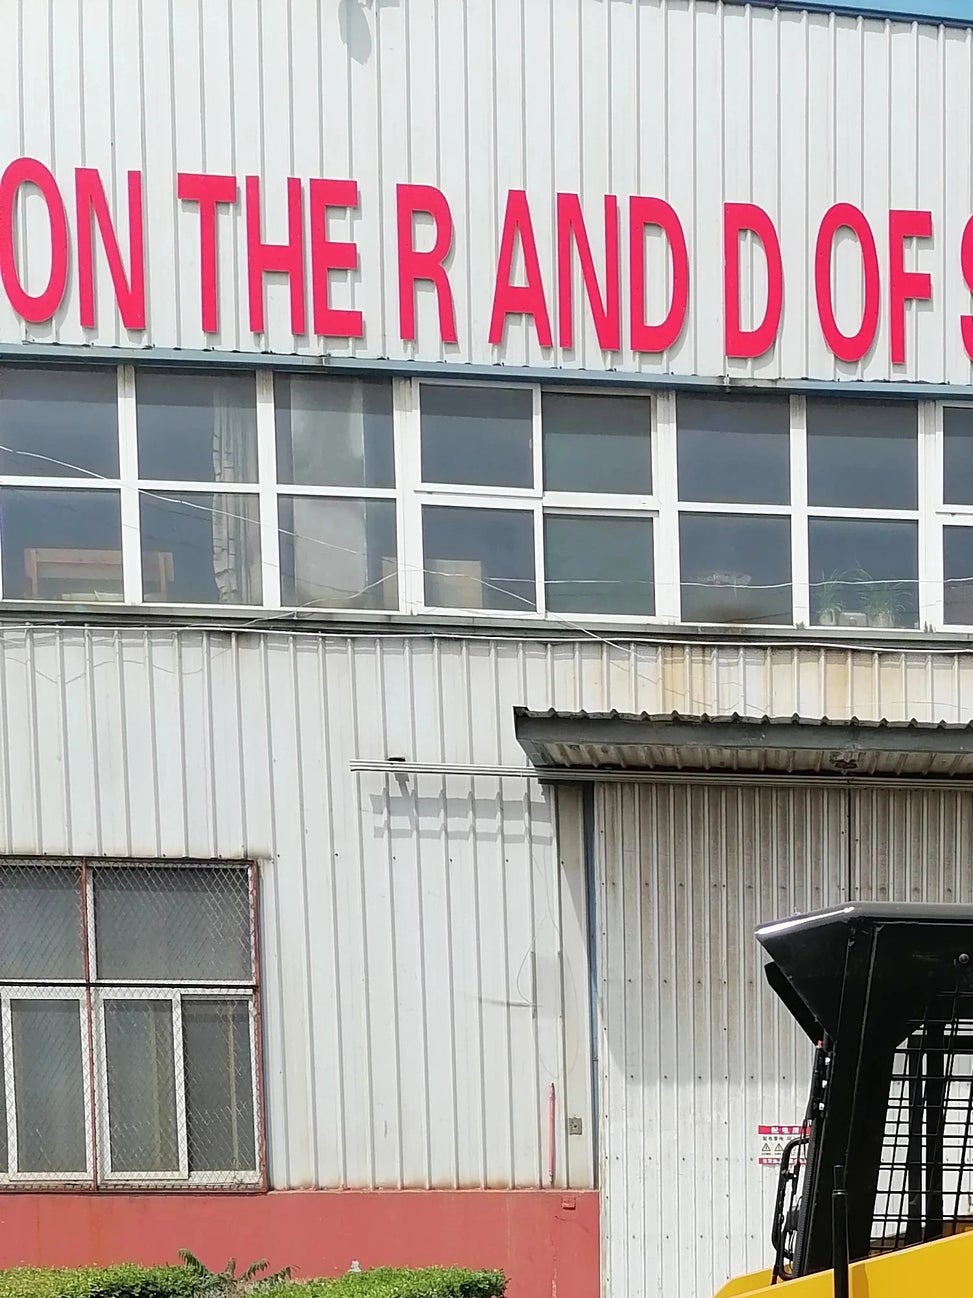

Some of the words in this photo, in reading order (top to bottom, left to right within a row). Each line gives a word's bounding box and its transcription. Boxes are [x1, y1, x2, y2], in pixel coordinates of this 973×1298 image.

[0, 158, 146, 329] ON
[178, 174, 363, 337] THE
[397, 184, 457, 342] R
[489, 190, 689, 353] AND
[724, 203, 783, 358] D
[815, 203, 933, 364] OF
